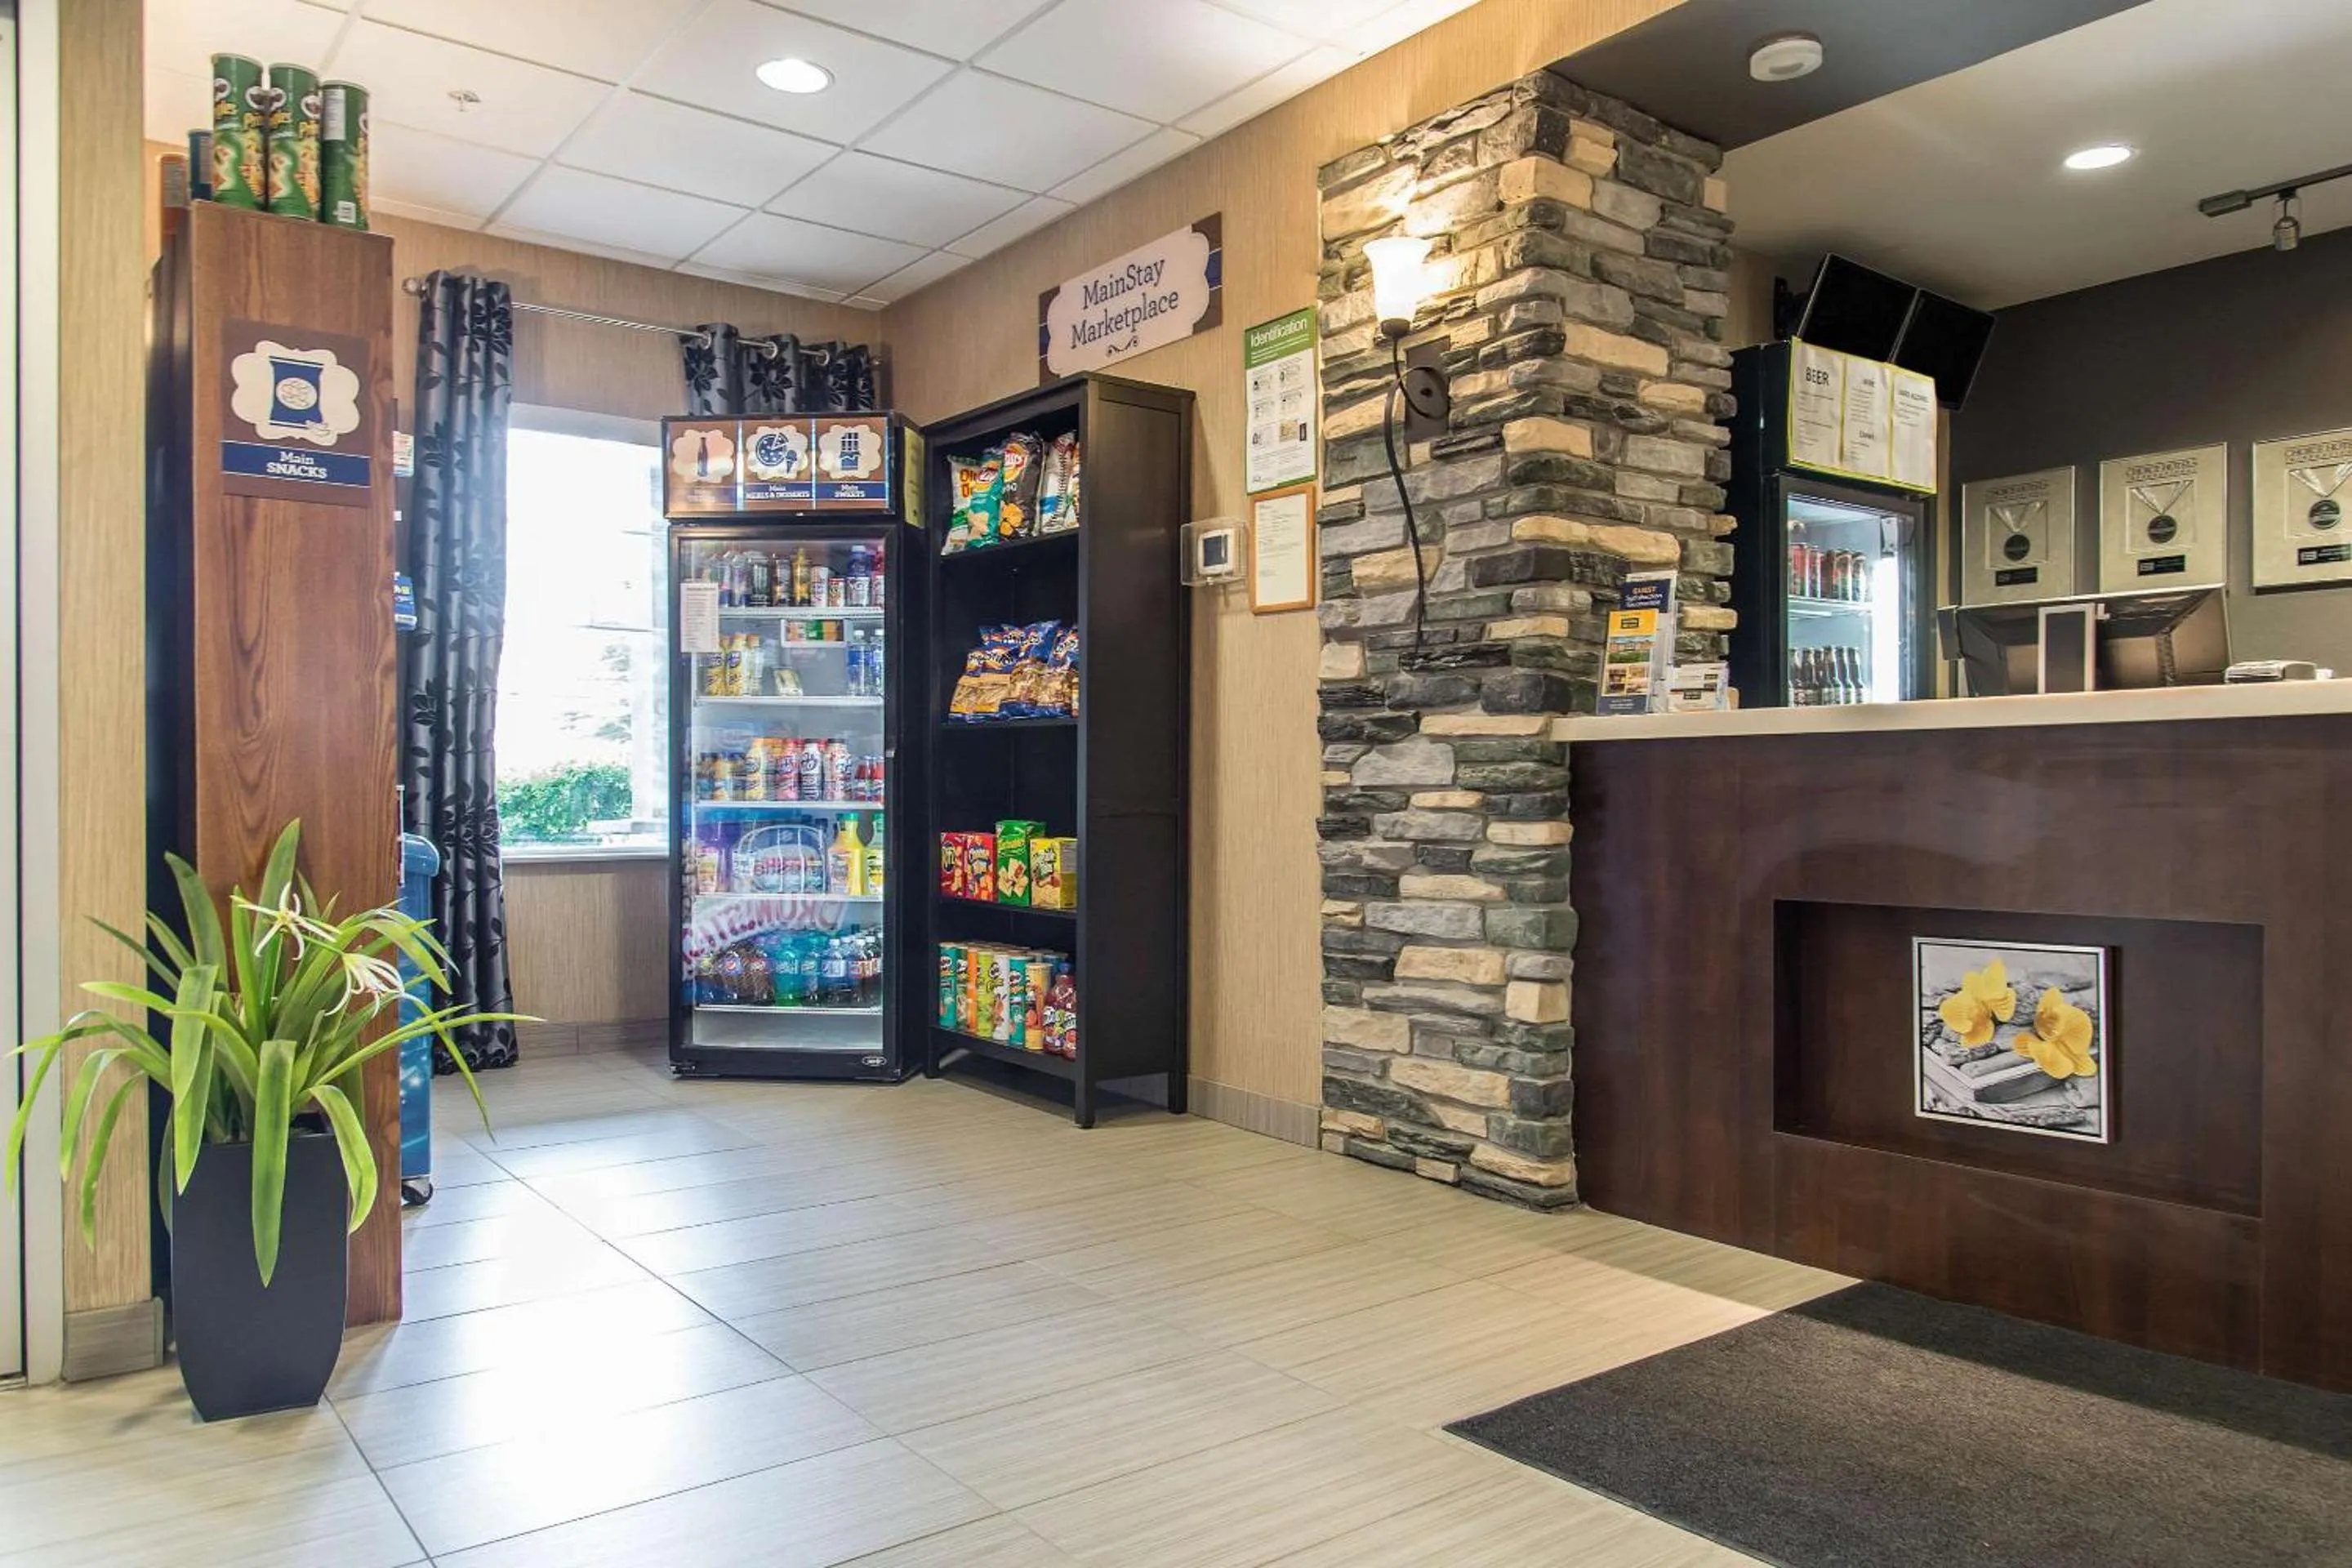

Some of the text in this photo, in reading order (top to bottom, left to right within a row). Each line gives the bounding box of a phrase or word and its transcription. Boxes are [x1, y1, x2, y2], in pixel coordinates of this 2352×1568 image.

[1082, 258, 1165, 310] MainStay
[1071, 291, 1179, 350] Marketplace
[1251, 318, 1307, 348] Identification
[1806, 366, 1830, 386] BEER
[266, 461, 327, 479] SNACKS
[279, 451, 314, 465] Main
